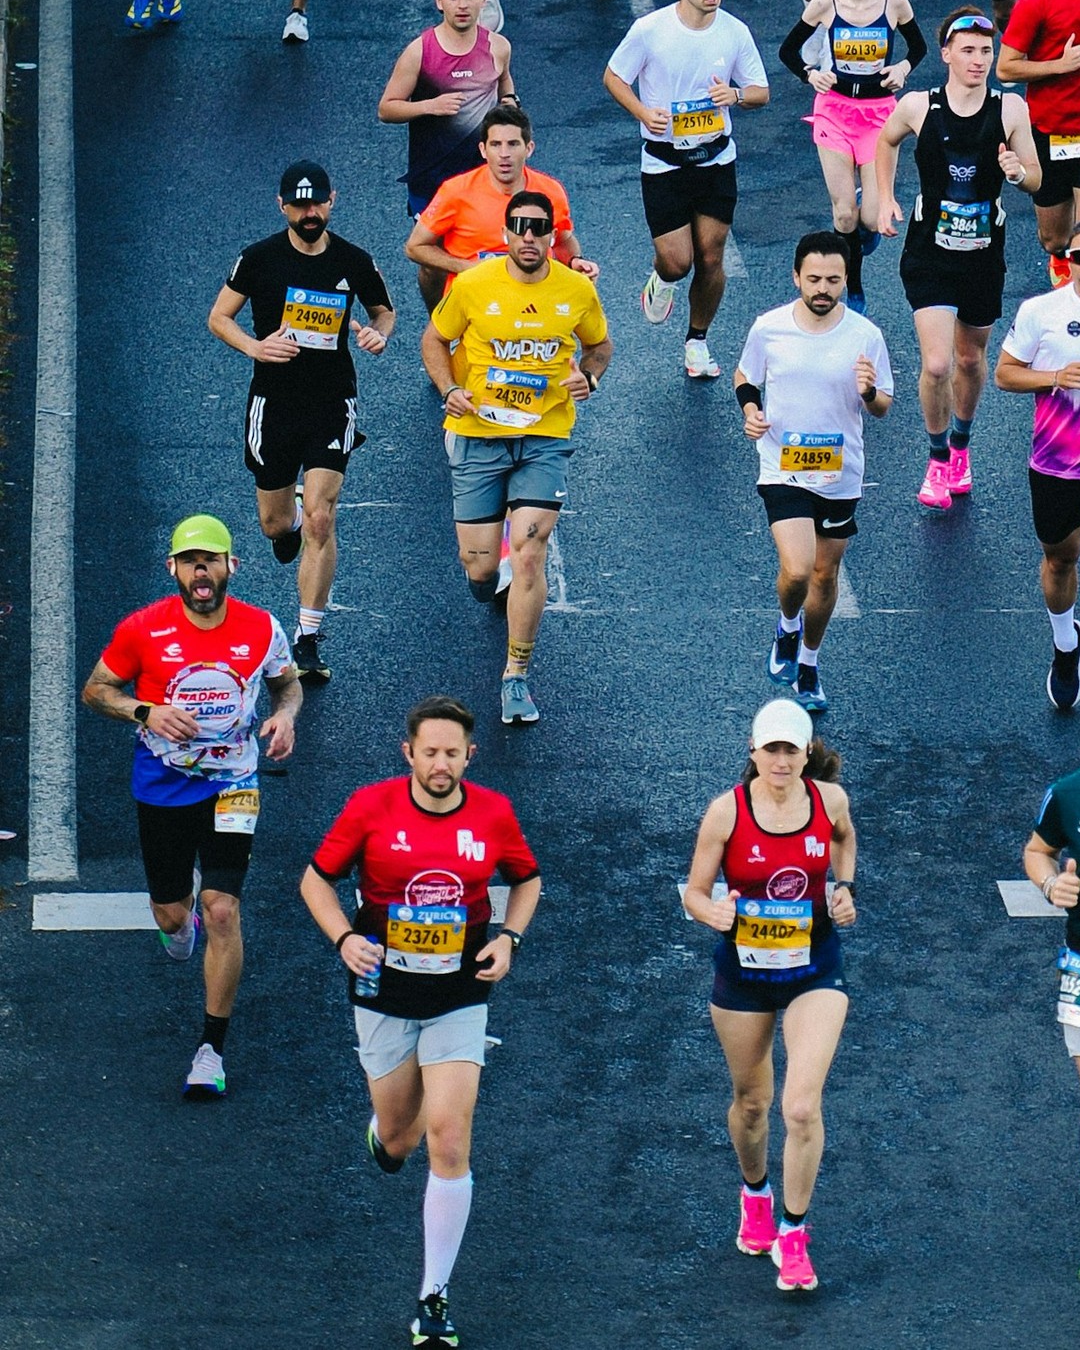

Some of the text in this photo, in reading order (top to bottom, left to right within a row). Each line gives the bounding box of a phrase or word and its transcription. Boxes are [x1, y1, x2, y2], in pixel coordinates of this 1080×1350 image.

[853, 30, 882, 39] ZURICH
[845, 43, 877, 57] 26139
[683, 114, 714, 129] 25176
[950, 216, 978, 232] 3864
[309, 295, 341, 307] ZURICH
[296, 308, 333, 327] 24906
[490, 337, 563, 363] MADRID
[510, 373, 542, 386] ZURICH
[495, 387, 532, 406] 24306
[804, 435, 838, 445] ZURICH
[793, 451, 832, 465] 24859
[177, 692, 230, 702] MADRID
[417, 910, 459, 921] ZURICH
[763, 906, 805, 918] ZURICH
[403, 928, 449, 945] 23761
